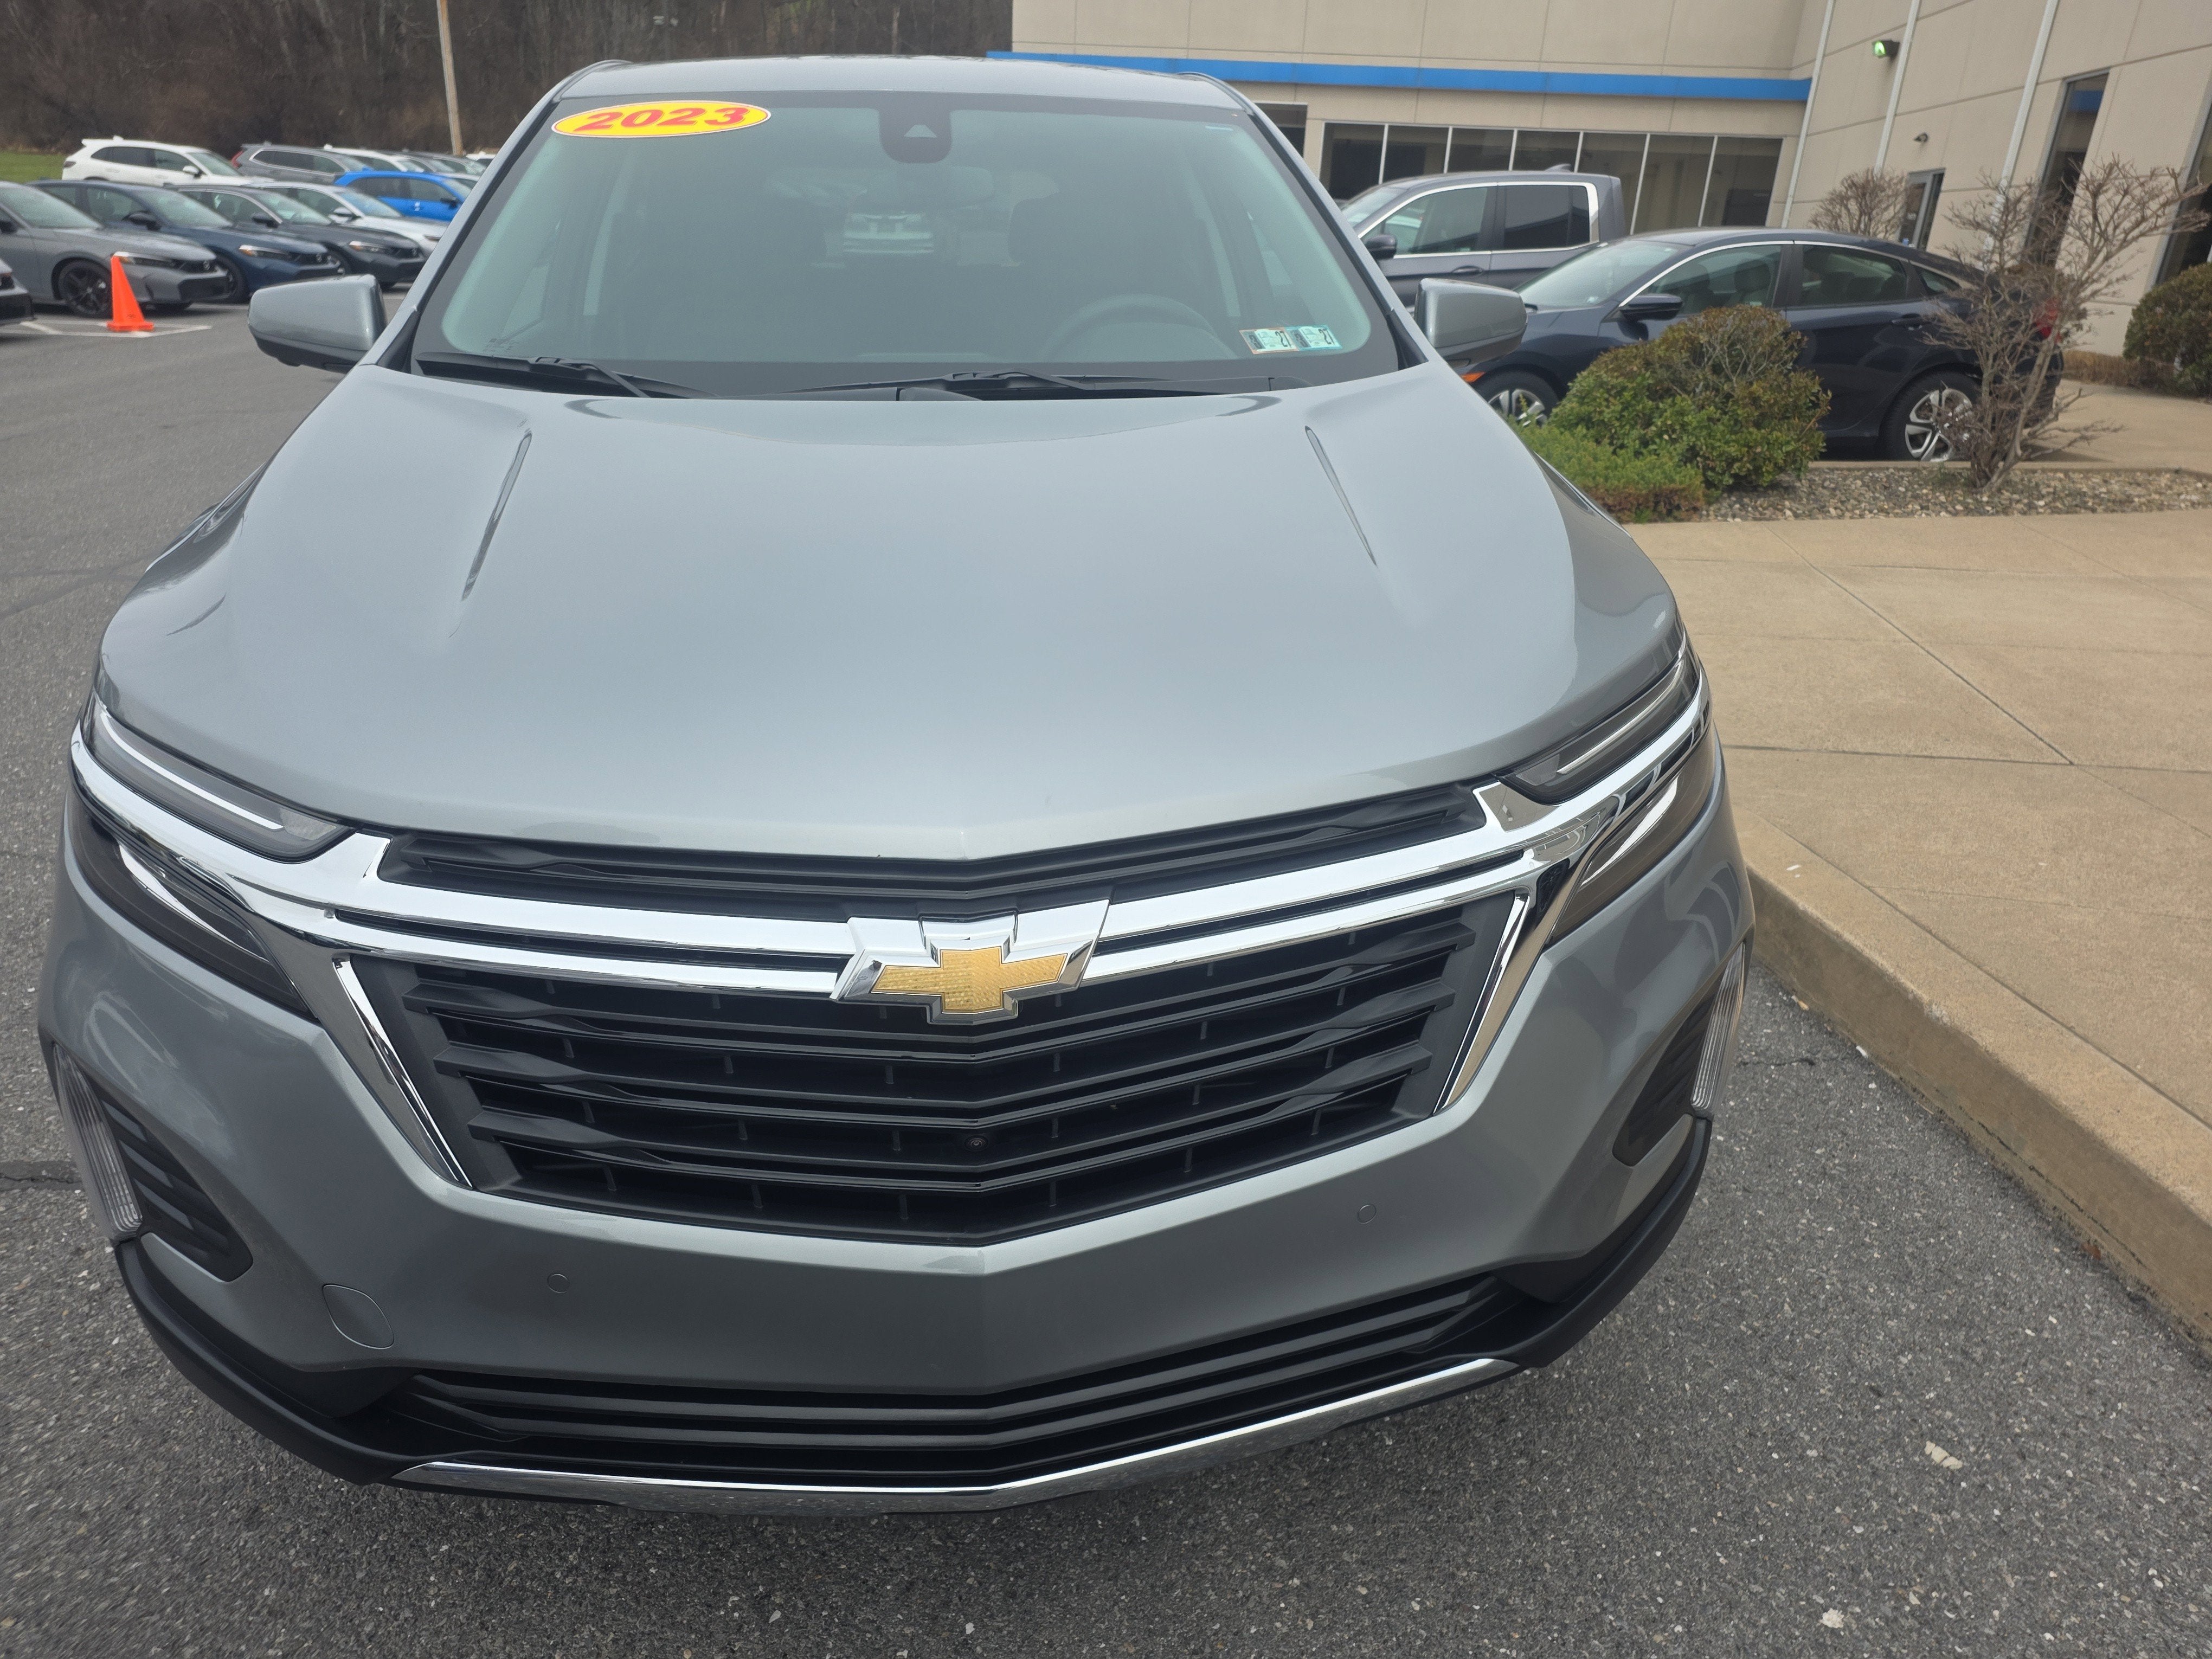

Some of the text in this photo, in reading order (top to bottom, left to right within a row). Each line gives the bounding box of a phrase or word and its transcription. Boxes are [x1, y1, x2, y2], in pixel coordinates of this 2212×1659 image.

[573, 108, 750, 131] 2023
[1275, 331, 1292, 348] 27
[1318, 328, 1335, 345] 27
